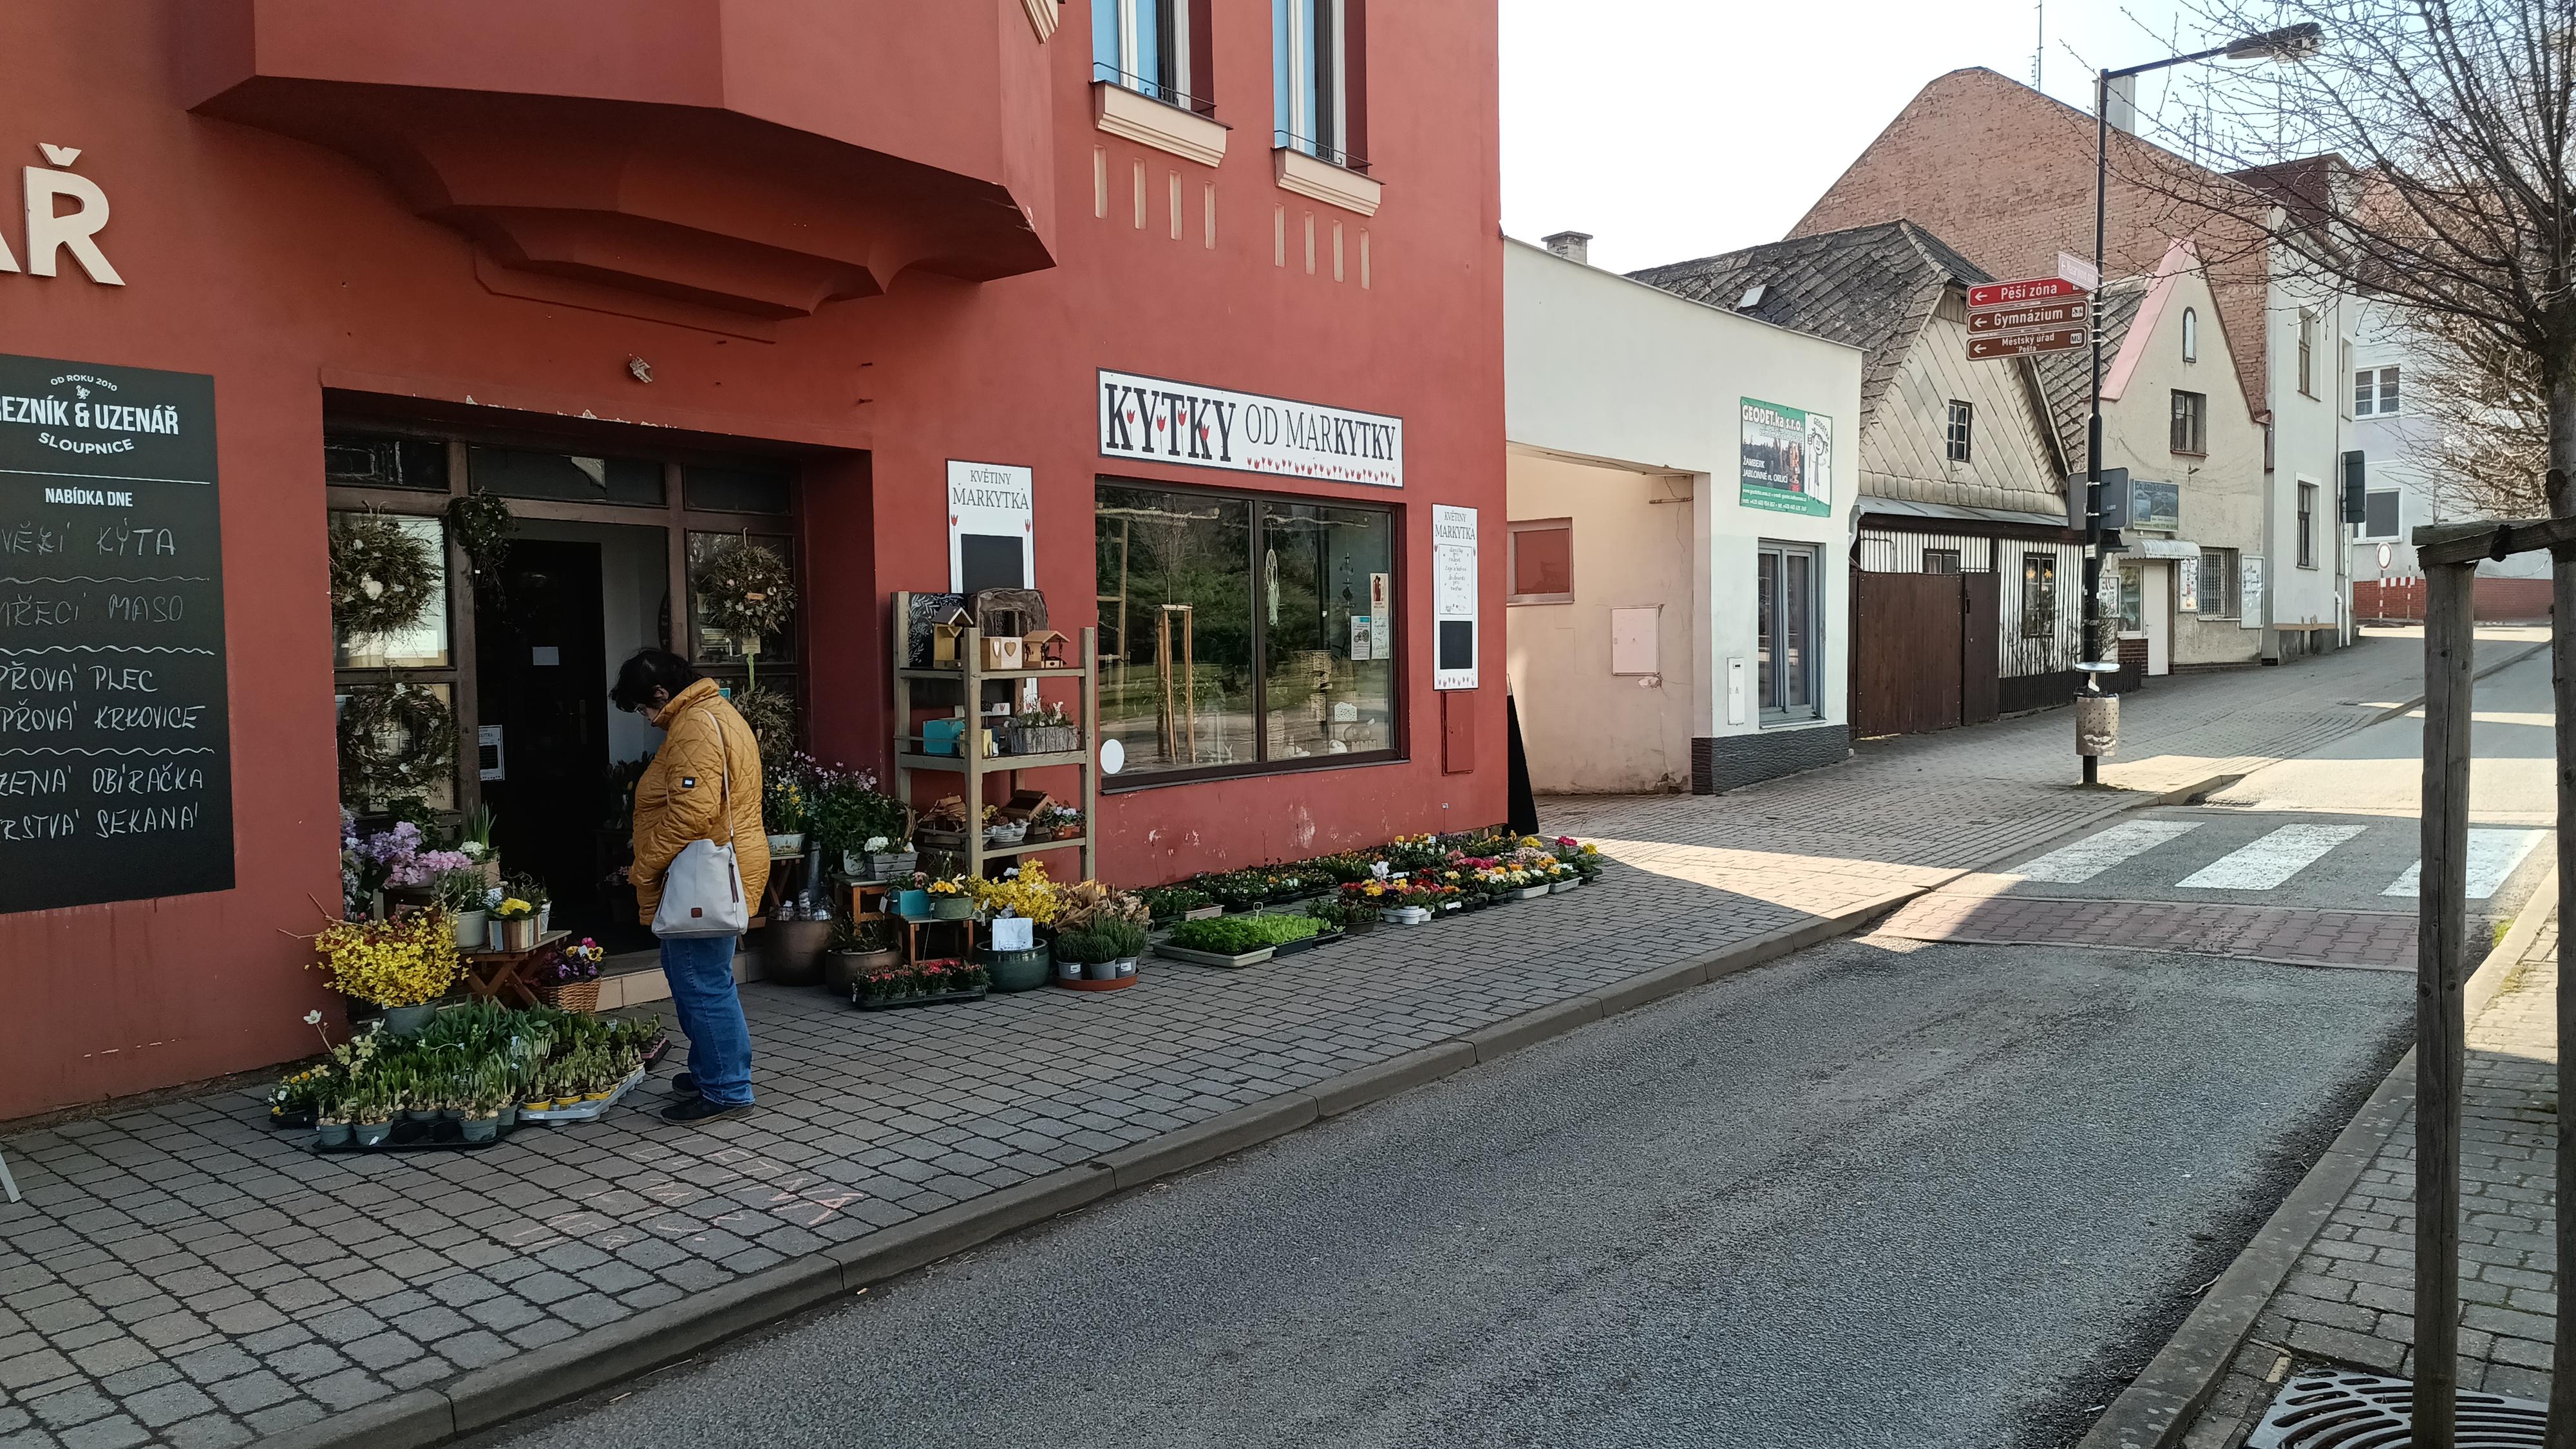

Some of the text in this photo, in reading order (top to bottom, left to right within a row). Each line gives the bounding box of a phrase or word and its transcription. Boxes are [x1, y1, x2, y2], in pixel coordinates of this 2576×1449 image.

[0, 142, 126, 286] Ř
[2001, 283, 2058, 300] Pěší zóna
[1994, 308, 2063, 328] Gymnázium
[2002, 332, 2055, 346] Městský úřad
[50, 374, 117, 392] OD ROKU 2010
[0, 395, 179, 435] EZNÍK & UZENÁŘ
[1104, 383, 1396, 462] KYTKY OD MARKYTKY
[1742, 404, 1803, 433] GEODET.ka s.r.o.
[38, 432, 135, 455] SLOUPNICE
[1742, 455, 1765, 469] ŽAMBERK
[970, 468, 1012, 485] KVĚTINY
[1742, 469, 1768, 480] JABLONNÉ
[45, 487, 133, 507] NABÍDKA DNE
[952, 487, 1030, 510] MARKYTKA
[1444, 510, 1467, 523] KVĚTINY
[97, 517, 176, 556] KÝTA
[1435, 524, 1476, 540] MARKYTKA
[108, 593, 183, 623] MASO
[88, 665, 158, 692] PLEC
[95, 706, 205, 731] KRKOVICE
[93, 762, 203, 795] OBÍRAČKA
[96, 802, 198, 838] SEKANÁ
